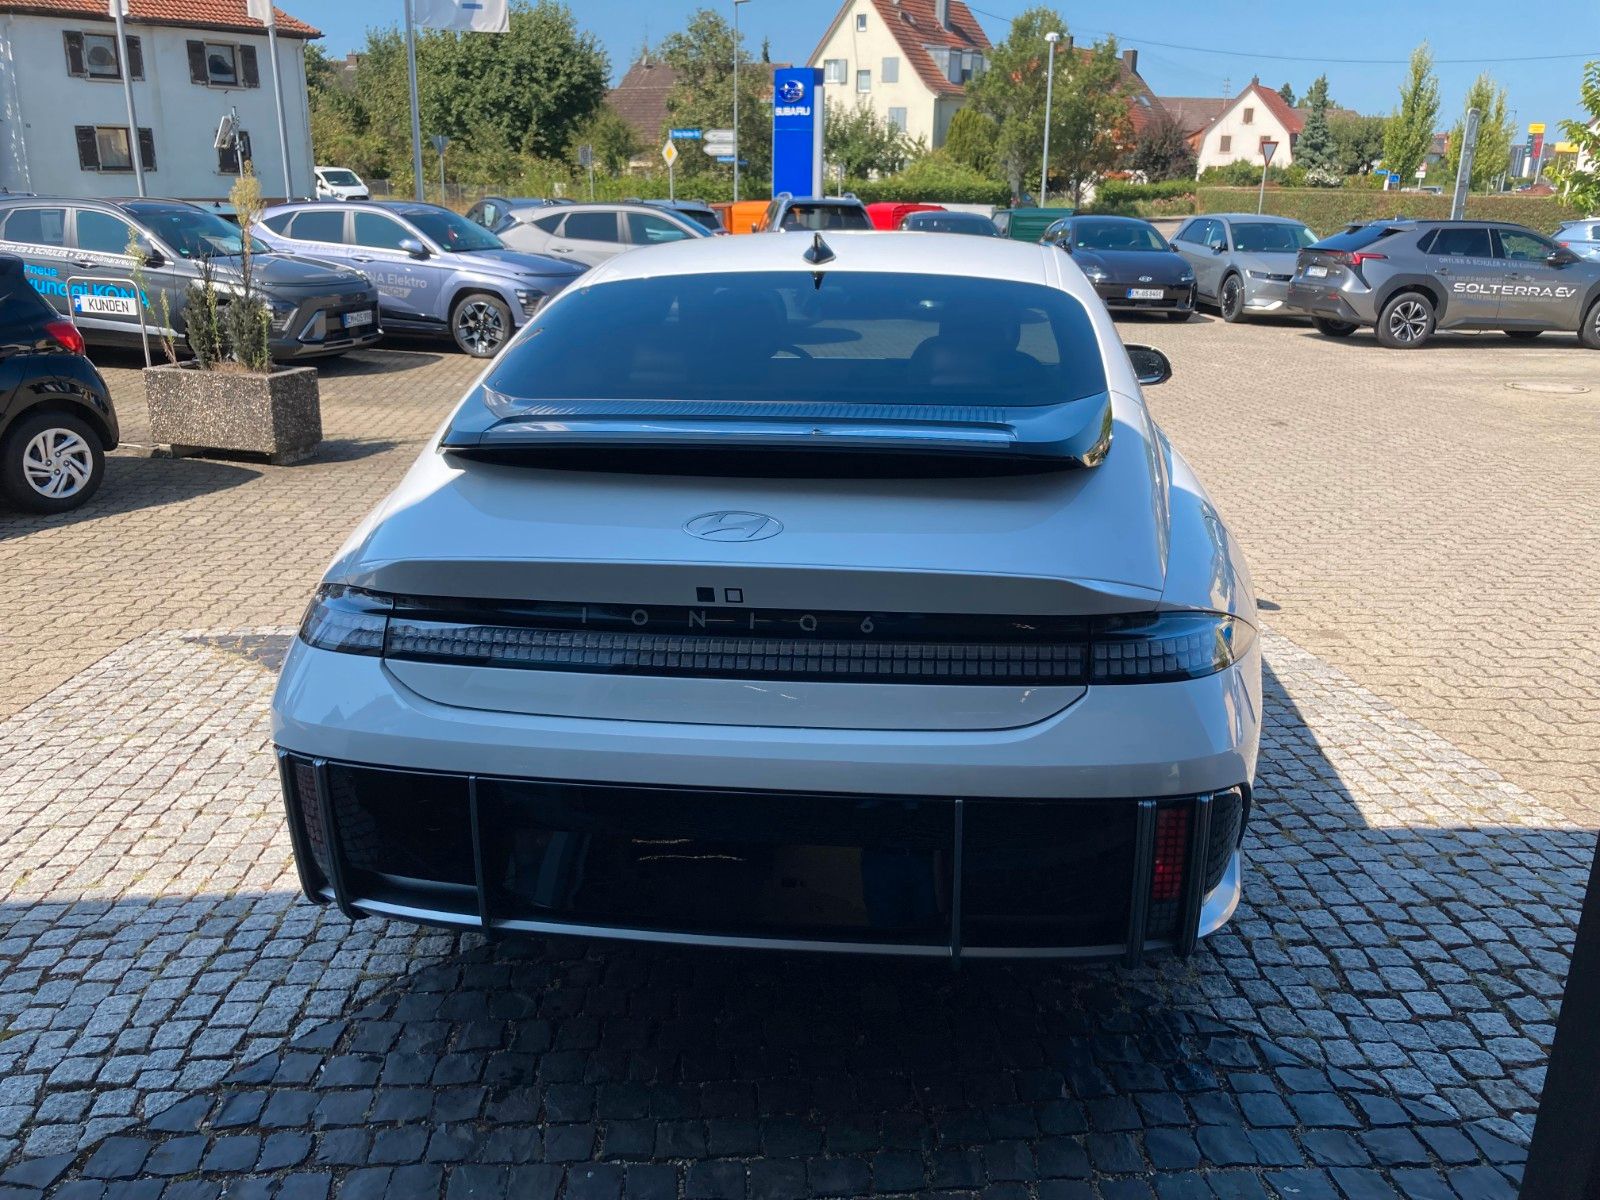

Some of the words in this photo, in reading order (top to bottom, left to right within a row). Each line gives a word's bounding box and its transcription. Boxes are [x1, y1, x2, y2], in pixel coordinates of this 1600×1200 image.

[775, 106, 811, 116] SUBARU
[387, 273, 428, 289] Elektro
[1453, 282, 1553, 297] SOLTERRA
[1554, 286, 1577, 298] EV
[88, 298, 130, 312] KUNDEN
[860, 615, 875, 633] 6
